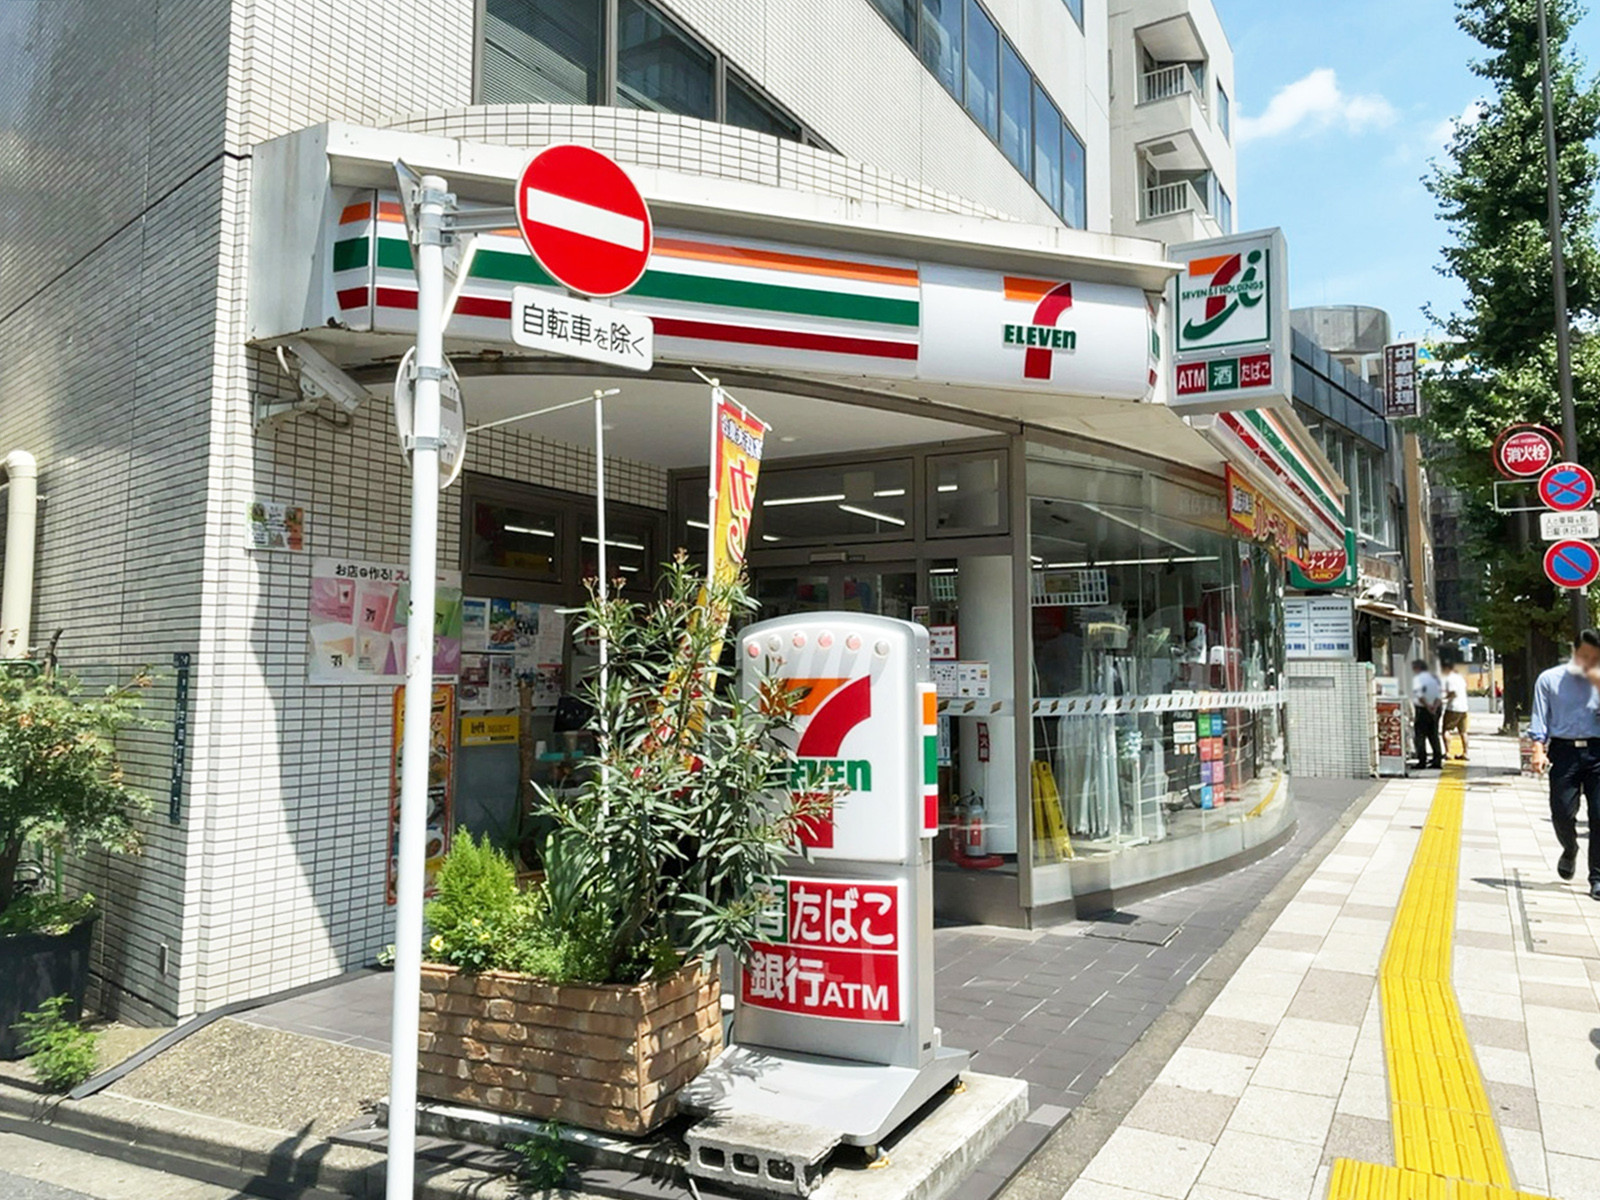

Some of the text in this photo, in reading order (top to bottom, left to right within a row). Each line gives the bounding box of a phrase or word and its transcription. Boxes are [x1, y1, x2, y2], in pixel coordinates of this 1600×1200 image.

[1220, 280, 1264, 295] HOLDINGS
[523, 302, 645, 357] 自転車を除く
[1003, 276, 1073, 379] 7
[1178, 368, 1206, 390] ATM
[1213, 364, 1233, 387] 酒
[1241, 361, 1271, 382] たばこ
[1506, 443, 1547, 464] 消火栓
[792, 885, 895, 945] たばこ
[749, 950, 890, 1012] 銀行ATM
